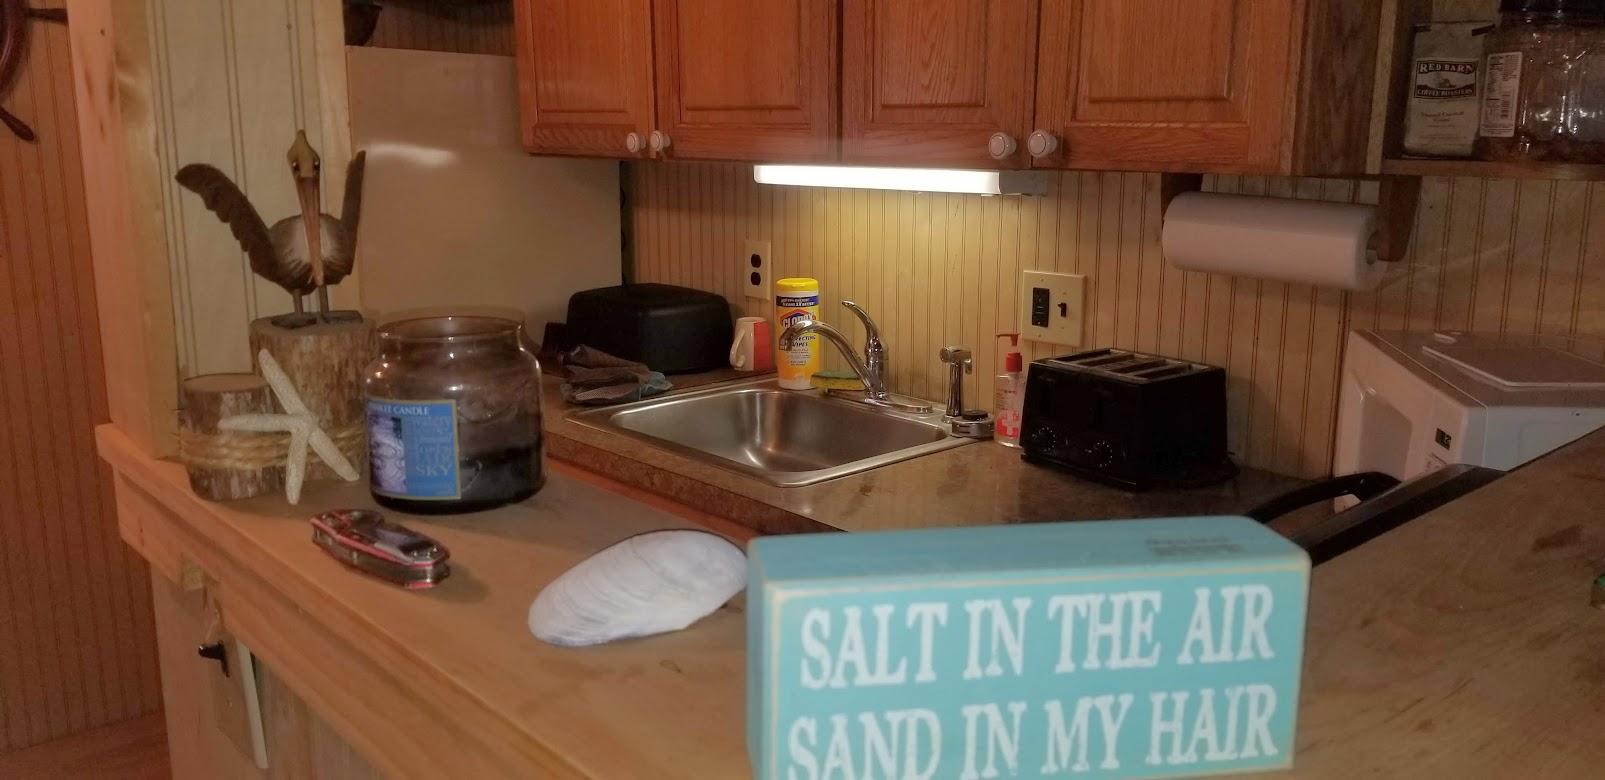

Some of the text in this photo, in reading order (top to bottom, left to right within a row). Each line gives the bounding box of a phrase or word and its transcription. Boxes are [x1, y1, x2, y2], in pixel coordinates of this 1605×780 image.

[1419, 63, 1474, 73] RED BARN
[1416, 88, 1439, 96] COFFEE
[392, 405, 429, 416] CANDLE
[416, 464, 451, 477] SKY
[801, 583, 1276, 690] SALT IN THE AIR
[787, 683, 1279, 780] SAND IN MY HAIR
